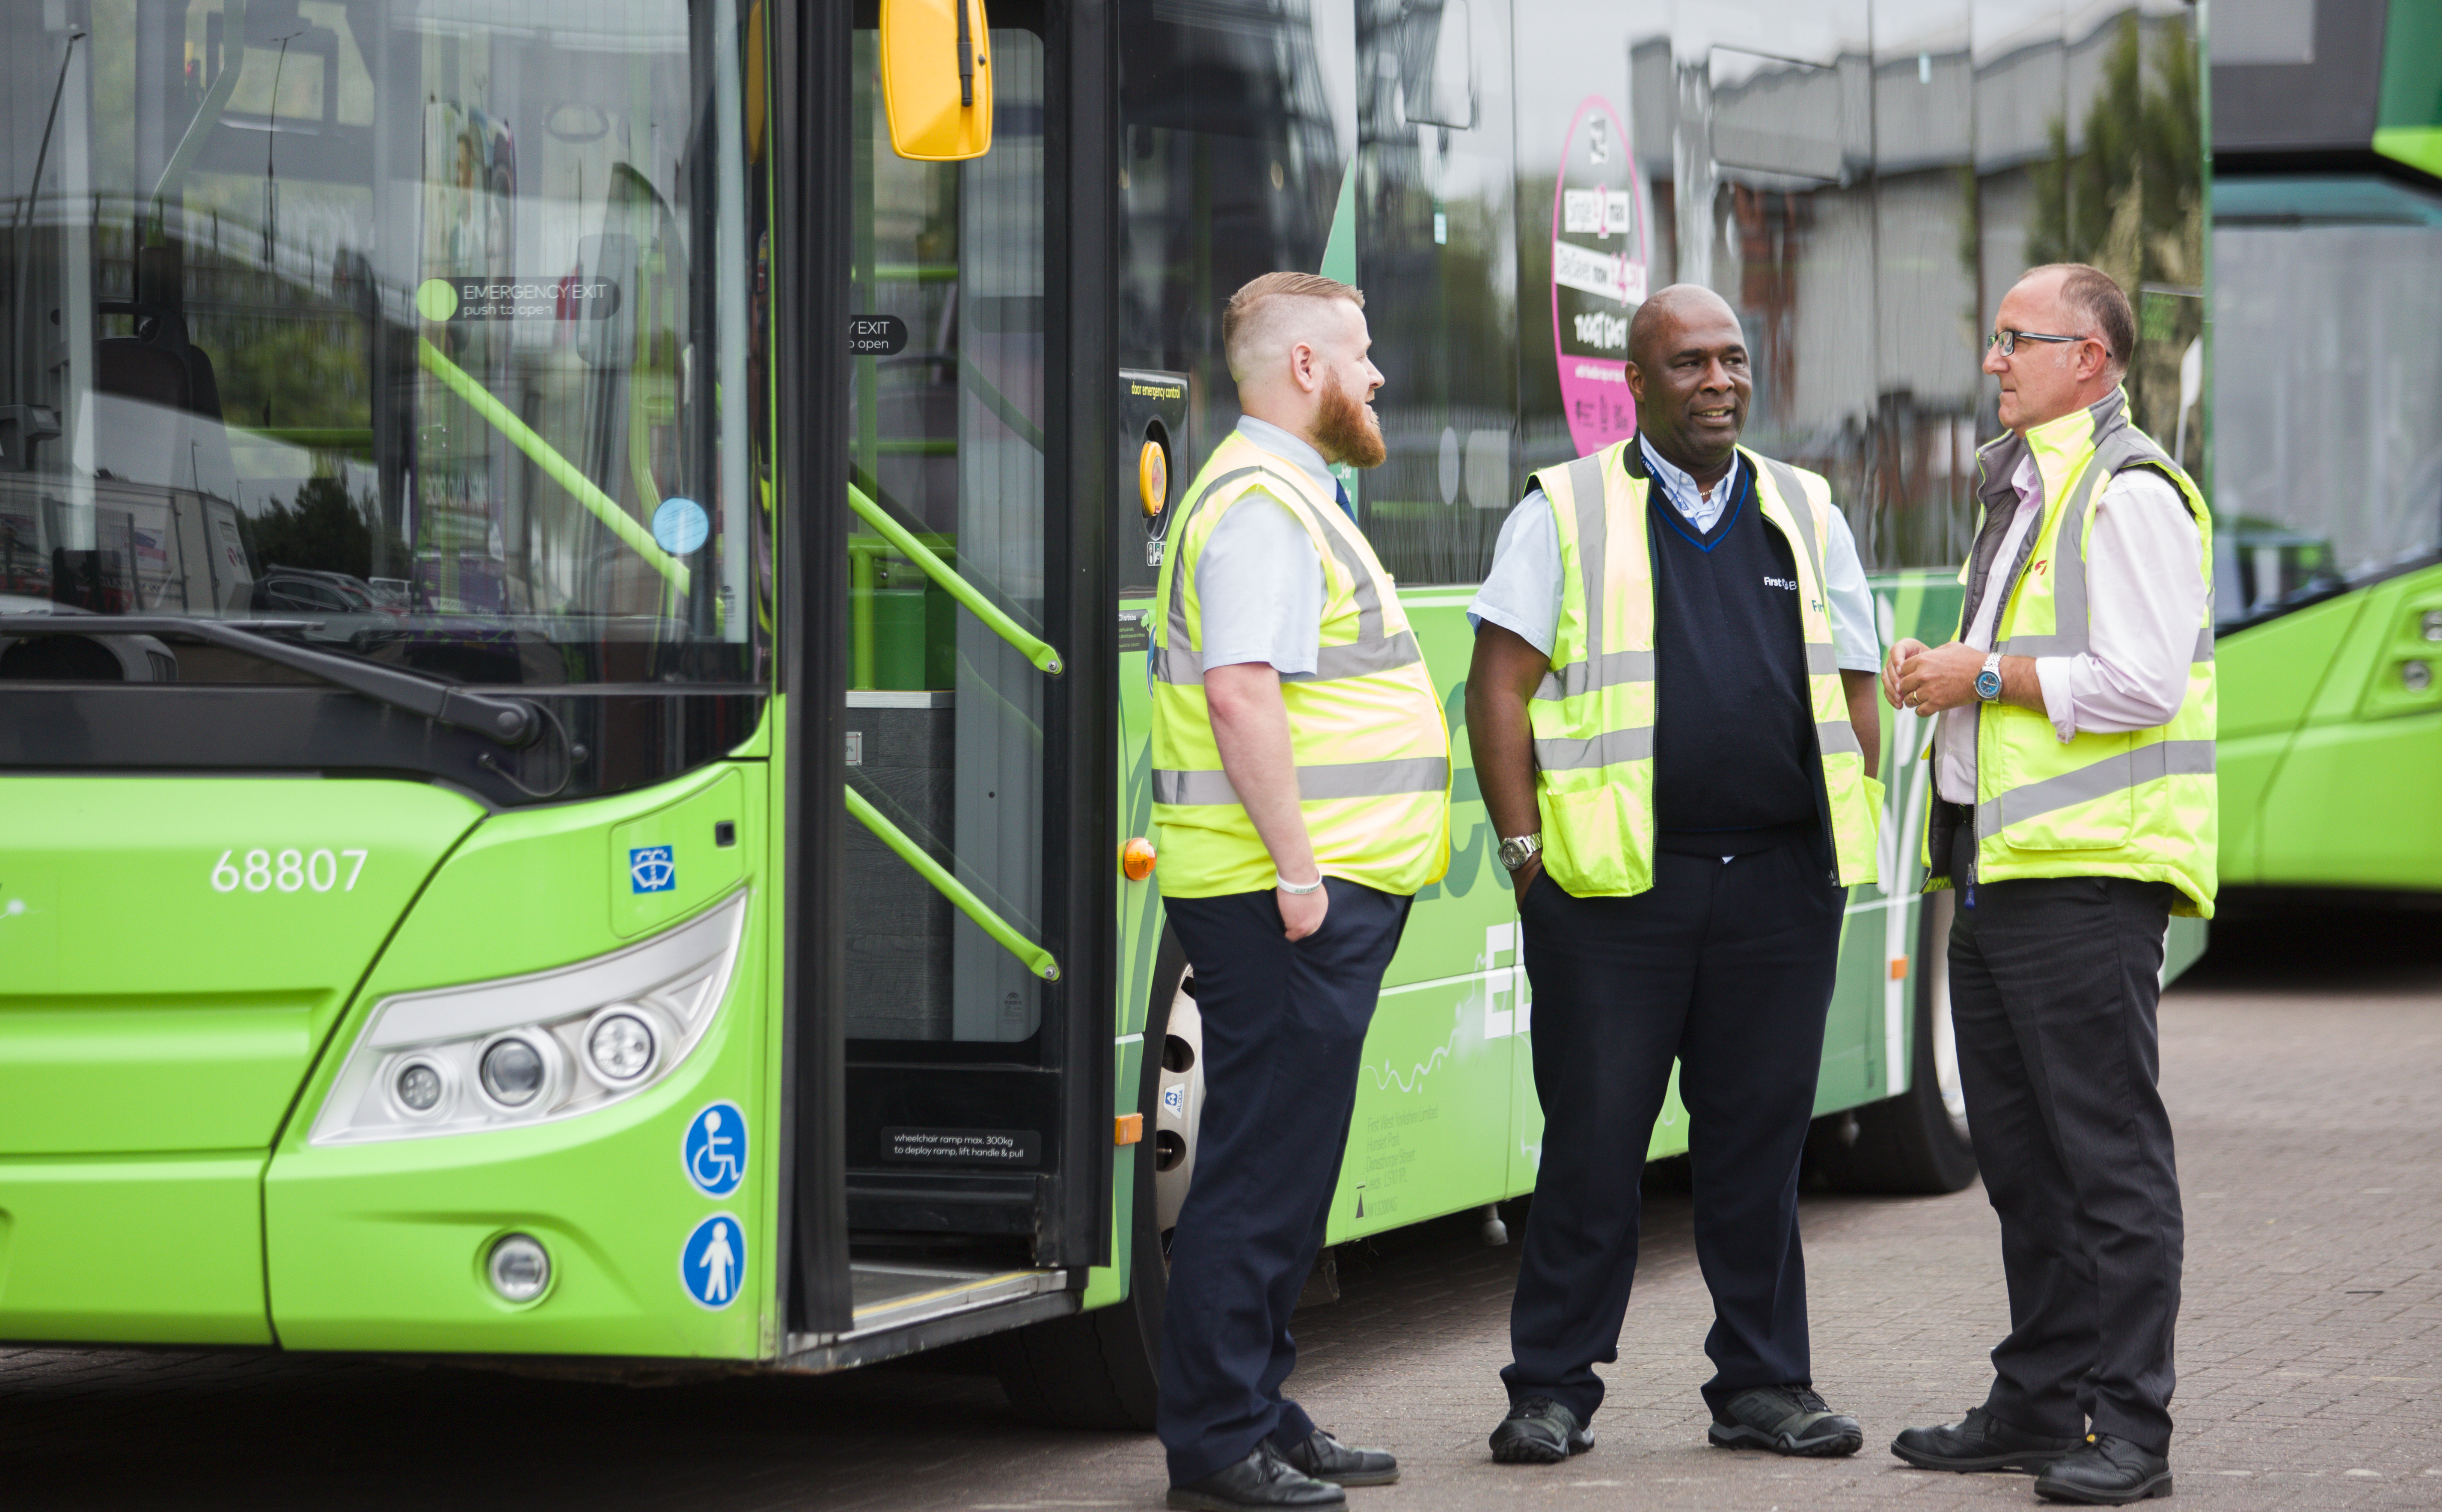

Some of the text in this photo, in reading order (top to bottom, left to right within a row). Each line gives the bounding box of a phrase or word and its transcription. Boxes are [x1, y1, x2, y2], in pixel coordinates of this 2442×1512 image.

[463, 284, 607, 299] EMERGENCY EXIT
[463, 304, 553, 318] push to open
[859, 321, 890, 335] EXIT
[858, 340, 889, 352] open
[1131, 380, 1180, 401] door emergency control
[1764, 576, 1782, 587] First
[211, 848, 369, 892] 68807
[1368, 1103, 1438, 1133] First West Yorkshire Limited
[894, 1133, 939, 1143] wheelchair
[940, 1136, 963, 1145] ramp
[986, 1136, 1013, 1147] 300kg
[1387, 1130, 1400, 1148] Park
[894, 1146, 1023, 1159] to deploy ramp, lift handle & pull
[1399, 1149, 1415, 1165] Street
[1366, 1174, 1381, 1192] Leeds
